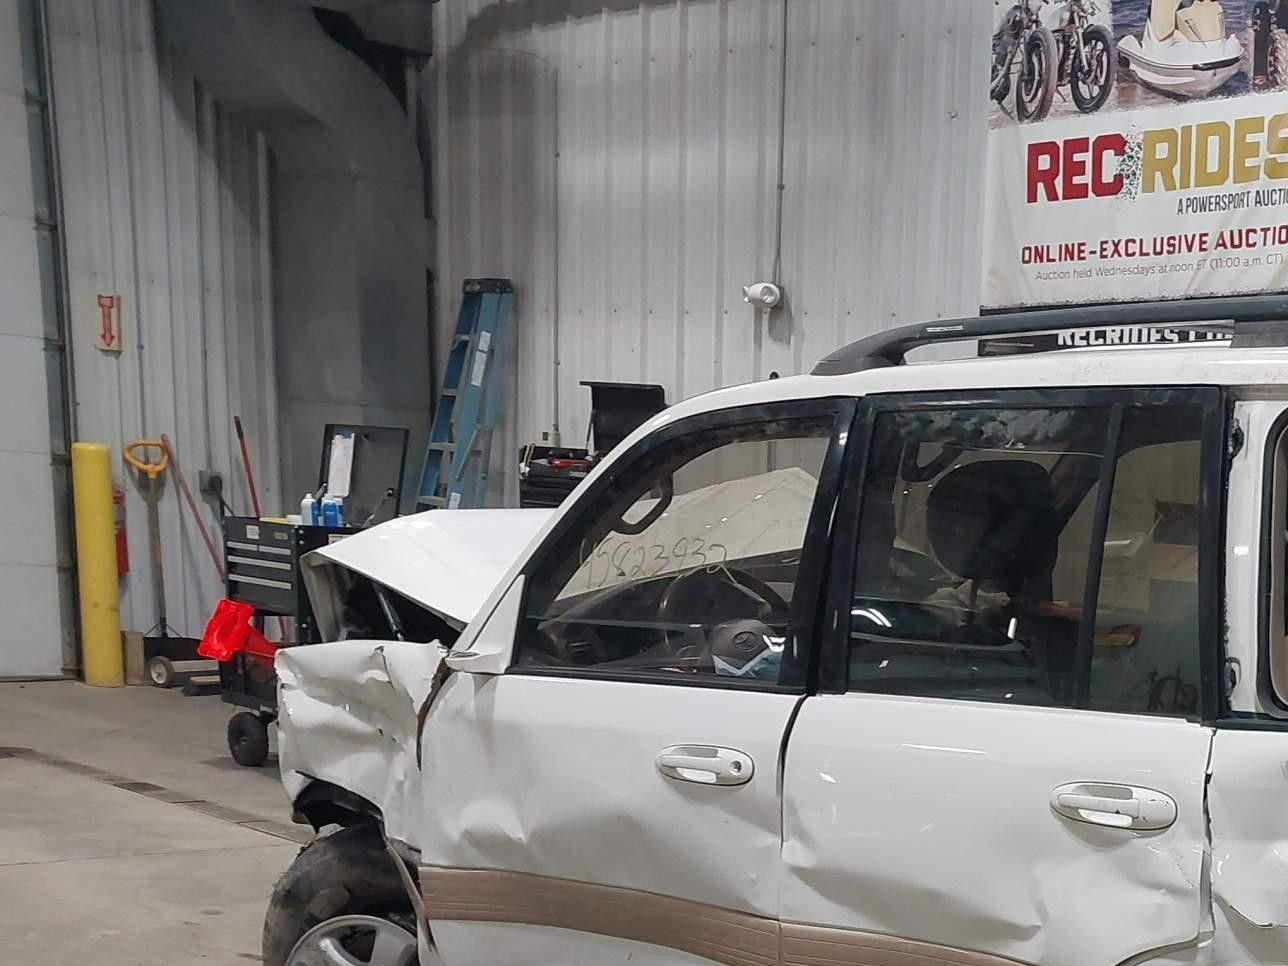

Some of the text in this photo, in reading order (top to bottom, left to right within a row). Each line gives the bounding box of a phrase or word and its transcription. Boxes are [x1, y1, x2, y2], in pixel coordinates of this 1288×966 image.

[1027, 133, 1127, 203] REC
[1177, 198, 1184, 215] A
[1186, 190, 1252, 214] POWERSPORT
[1021, 232, 1209, 264] ONLINE-EXCLUSIVE
[1035, 269, 1071, 281] Auction
[1073, 267, 1092, 279] held
[1094, 264, 1155, 277] Wednesdays
[1169, 262, 1194, 273] noon
[1209, 257, 1240, 271] (11:00
